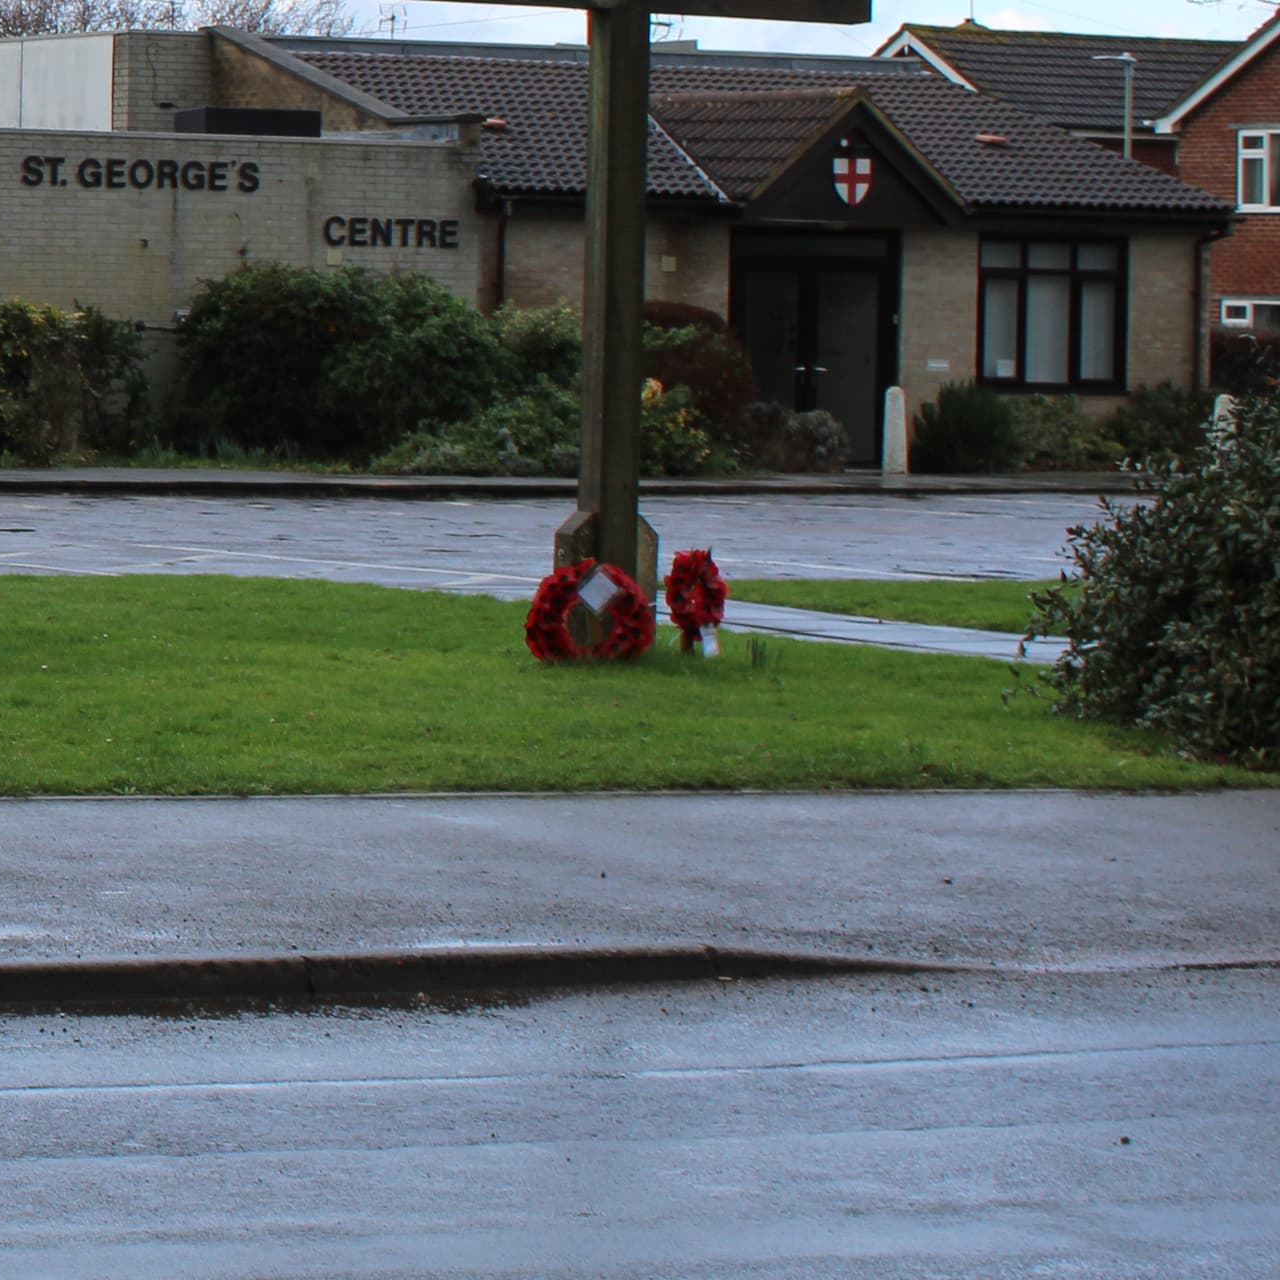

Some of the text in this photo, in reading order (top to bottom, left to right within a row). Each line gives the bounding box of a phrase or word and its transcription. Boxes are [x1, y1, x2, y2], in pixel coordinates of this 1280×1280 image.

[21, 155, 261, 193] ST. GEORGE'S
[324, 216, 459, 248] CENTRE
